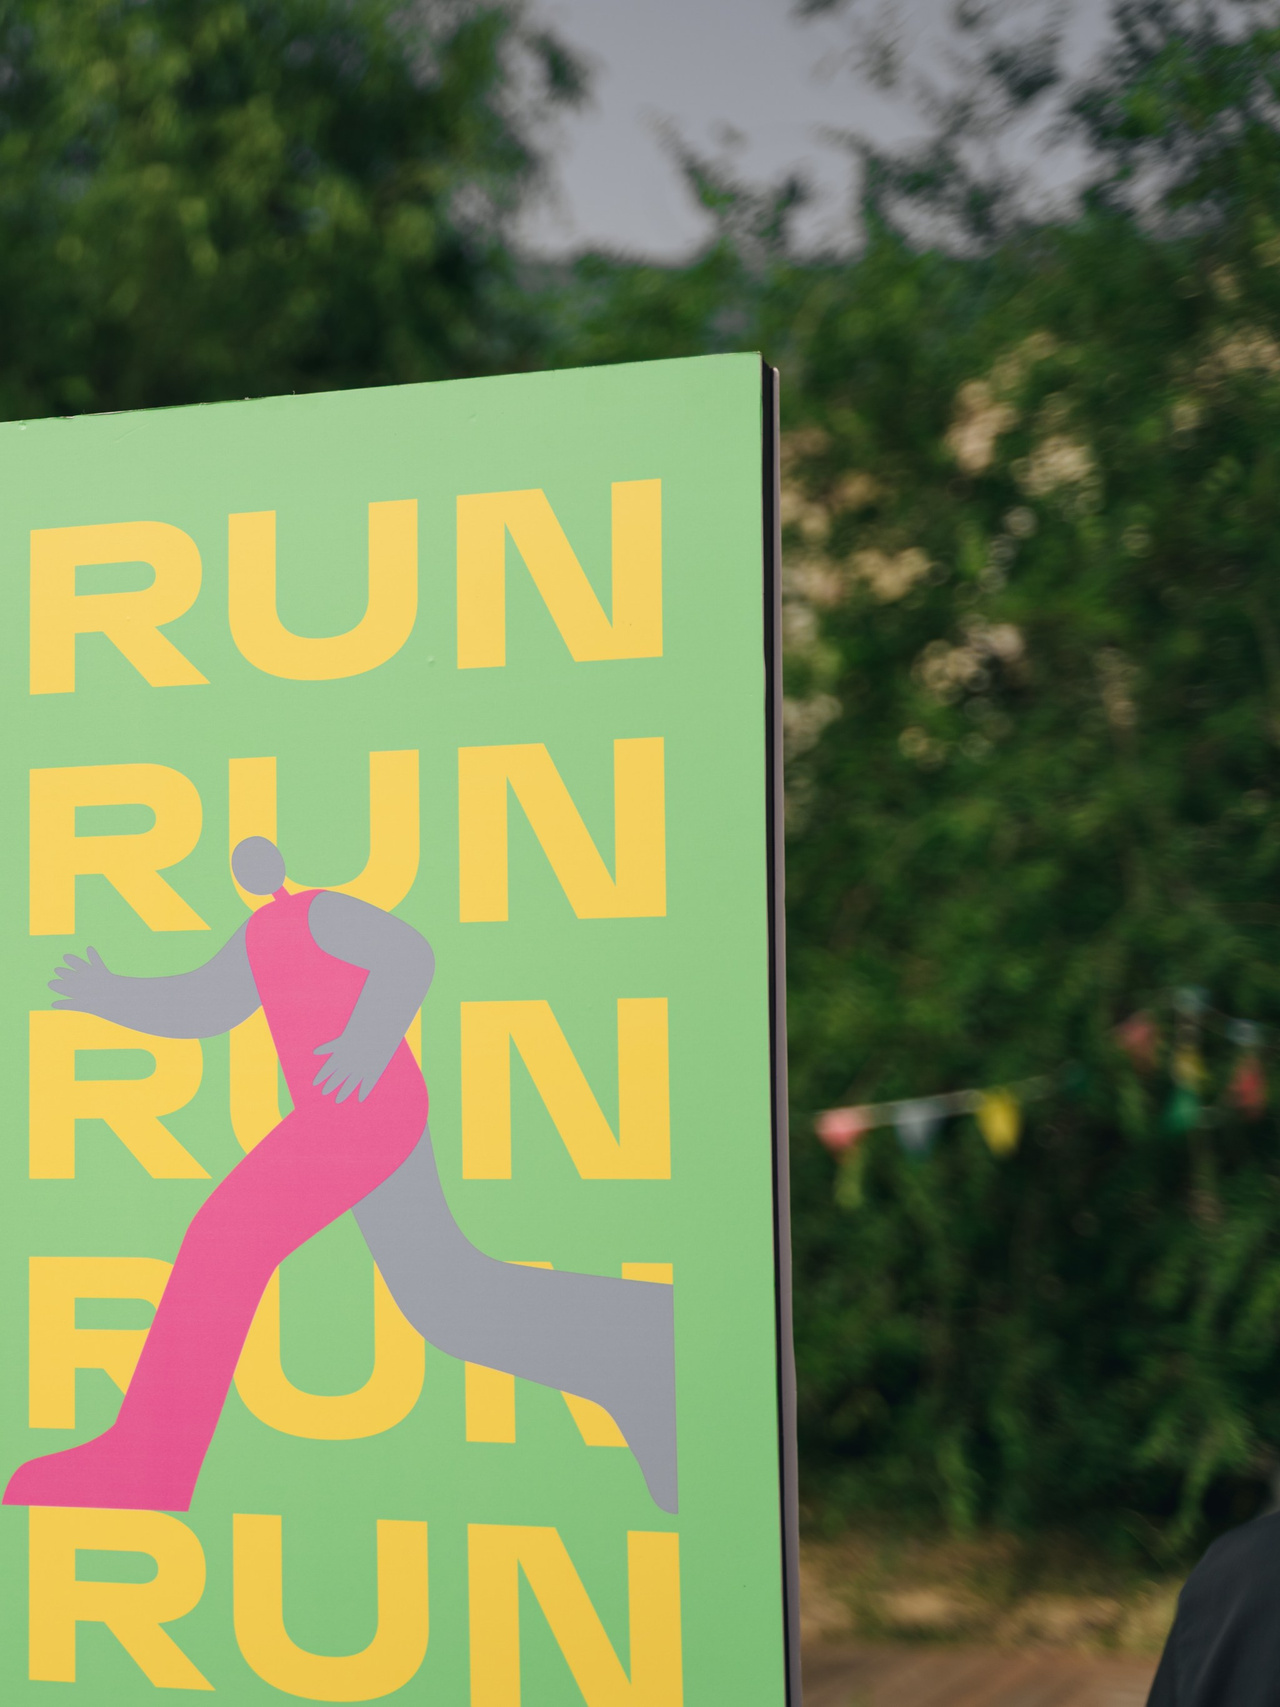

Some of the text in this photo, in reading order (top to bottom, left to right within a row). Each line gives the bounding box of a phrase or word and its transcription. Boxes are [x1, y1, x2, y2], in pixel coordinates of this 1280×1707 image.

[29, 478, 665, 696] RUN
[29, 736, 668, 937] RUN
[28, 1256, 675, 1448] RU
[28, 1505, 684, 1707] RUN
